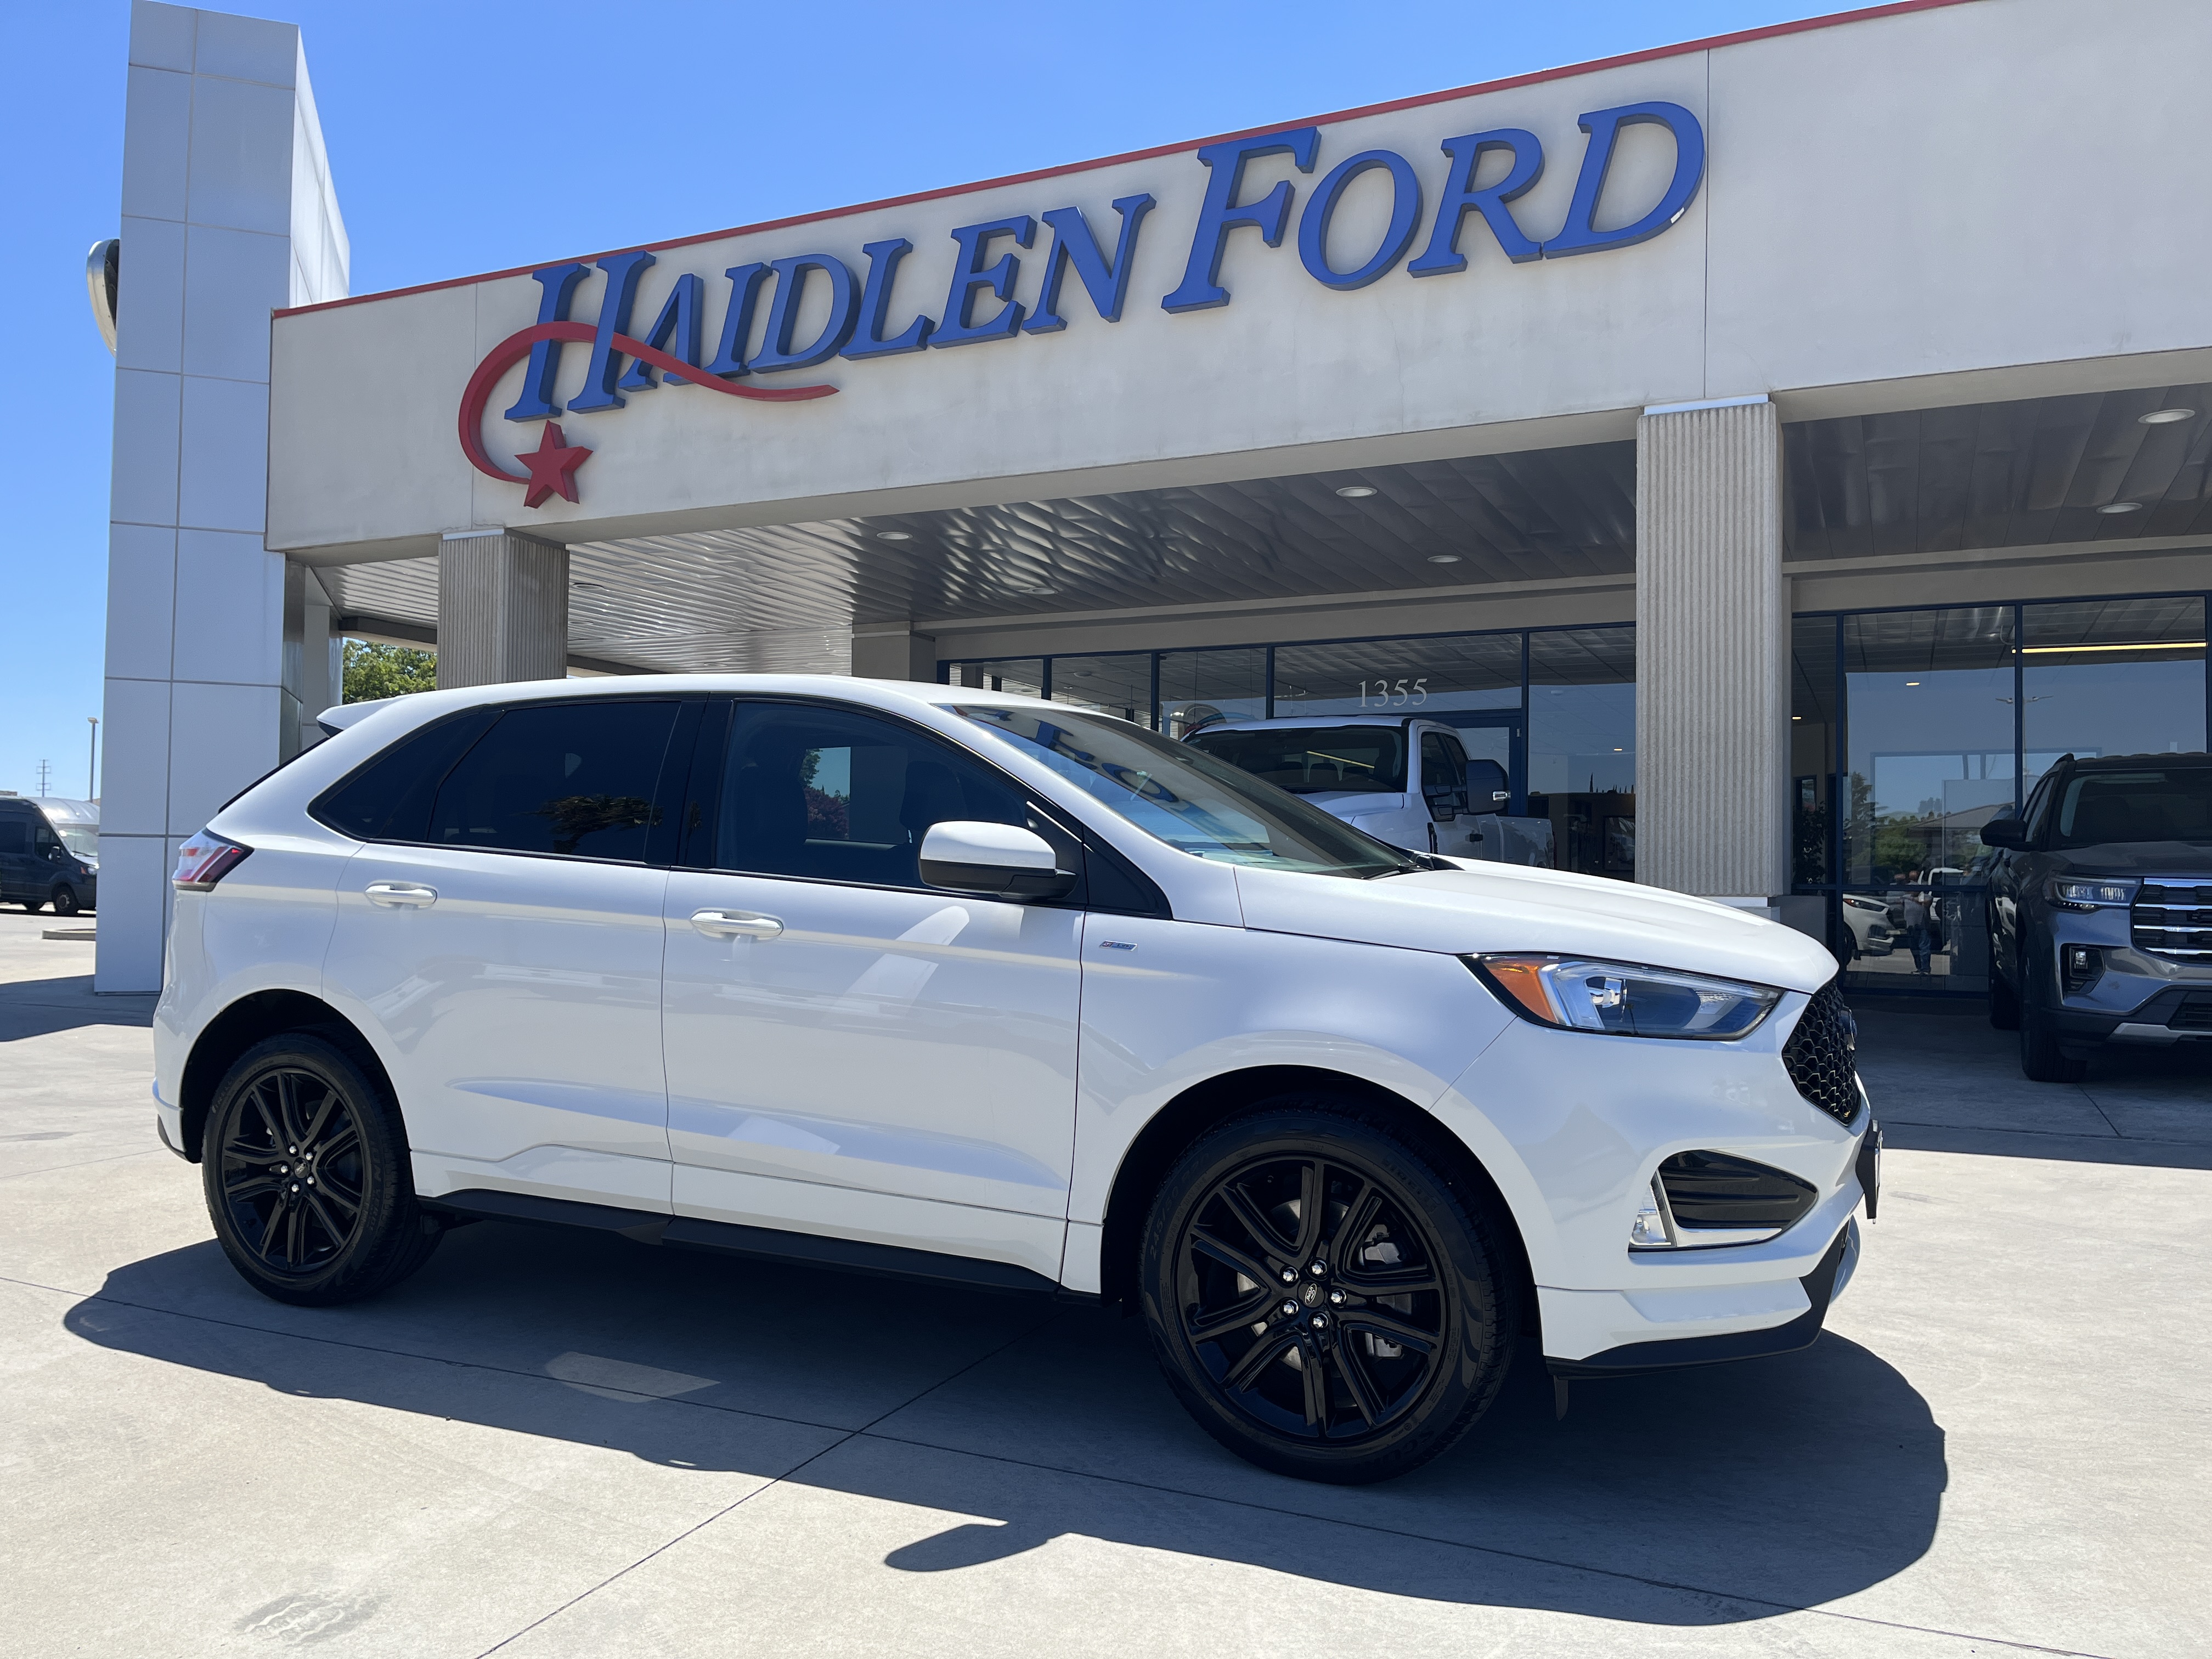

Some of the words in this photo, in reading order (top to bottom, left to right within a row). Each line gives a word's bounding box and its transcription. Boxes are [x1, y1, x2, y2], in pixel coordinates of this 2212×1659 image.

[504, 194, 1156, 423] HAIDLEN
[1161, 101, 1706, 314] FORD
[1358, 678, 1427, 707] 1355
